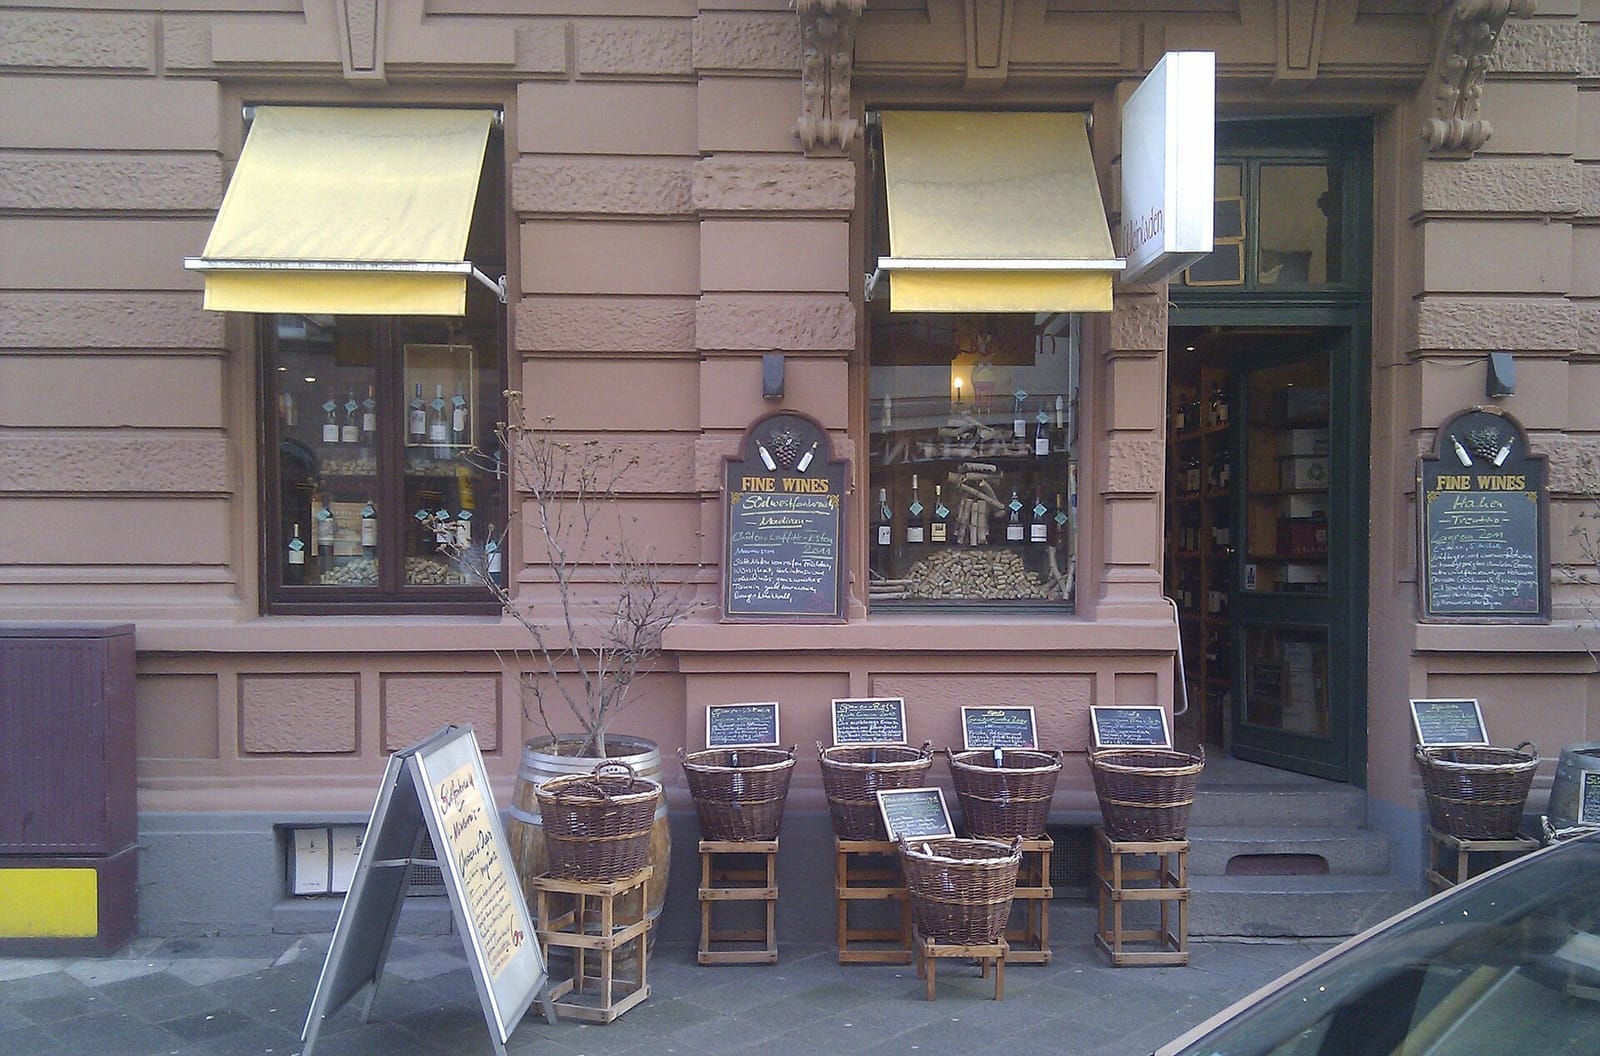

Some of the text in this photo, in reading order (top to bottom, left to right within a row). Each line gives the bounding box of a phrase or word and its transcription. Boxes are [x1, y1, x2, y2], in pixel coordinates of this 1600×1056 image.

[741, 476, 829, 493] FINE WINES
[1436, 475, 1526, 491] FINE WINES
